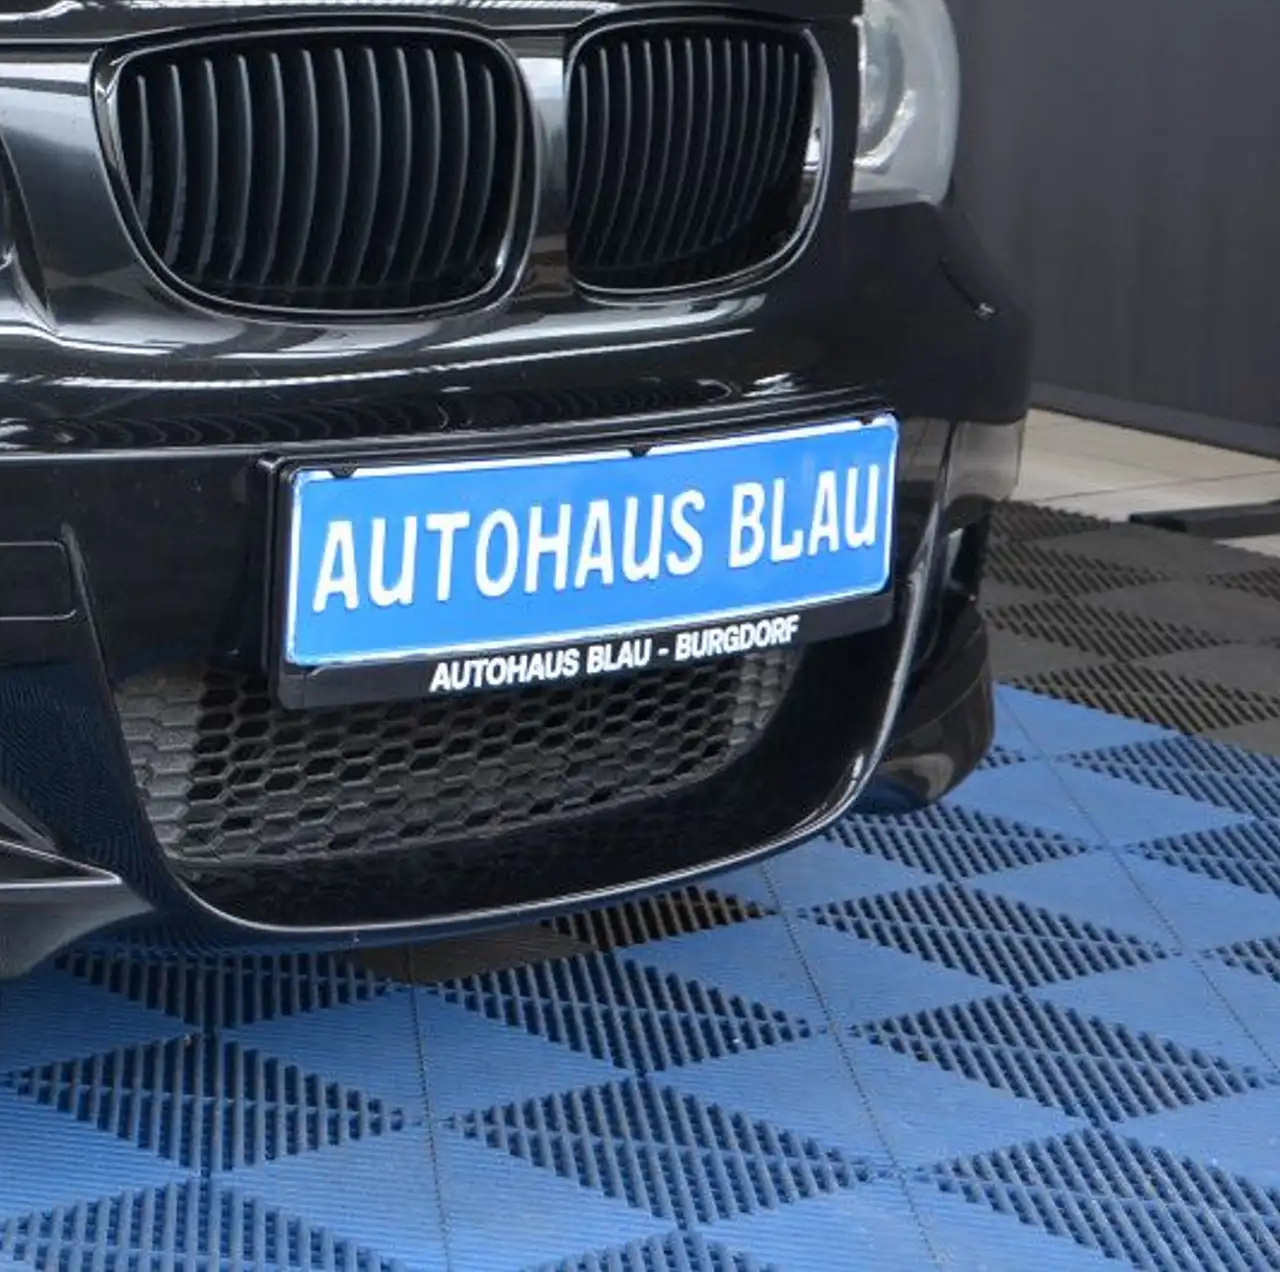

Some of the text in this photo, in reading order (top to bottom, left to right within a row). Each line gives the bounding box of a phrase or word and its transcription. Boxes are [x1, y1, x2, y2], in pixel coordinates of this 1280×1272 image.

[313, 464, 880, 612] AUTOHAUS BLAU
[428, 649, 581, 693] AUTOHAUS
[586, 637, 652, 675] BLAU
[674, 614, 801, 662] BURGDORF
